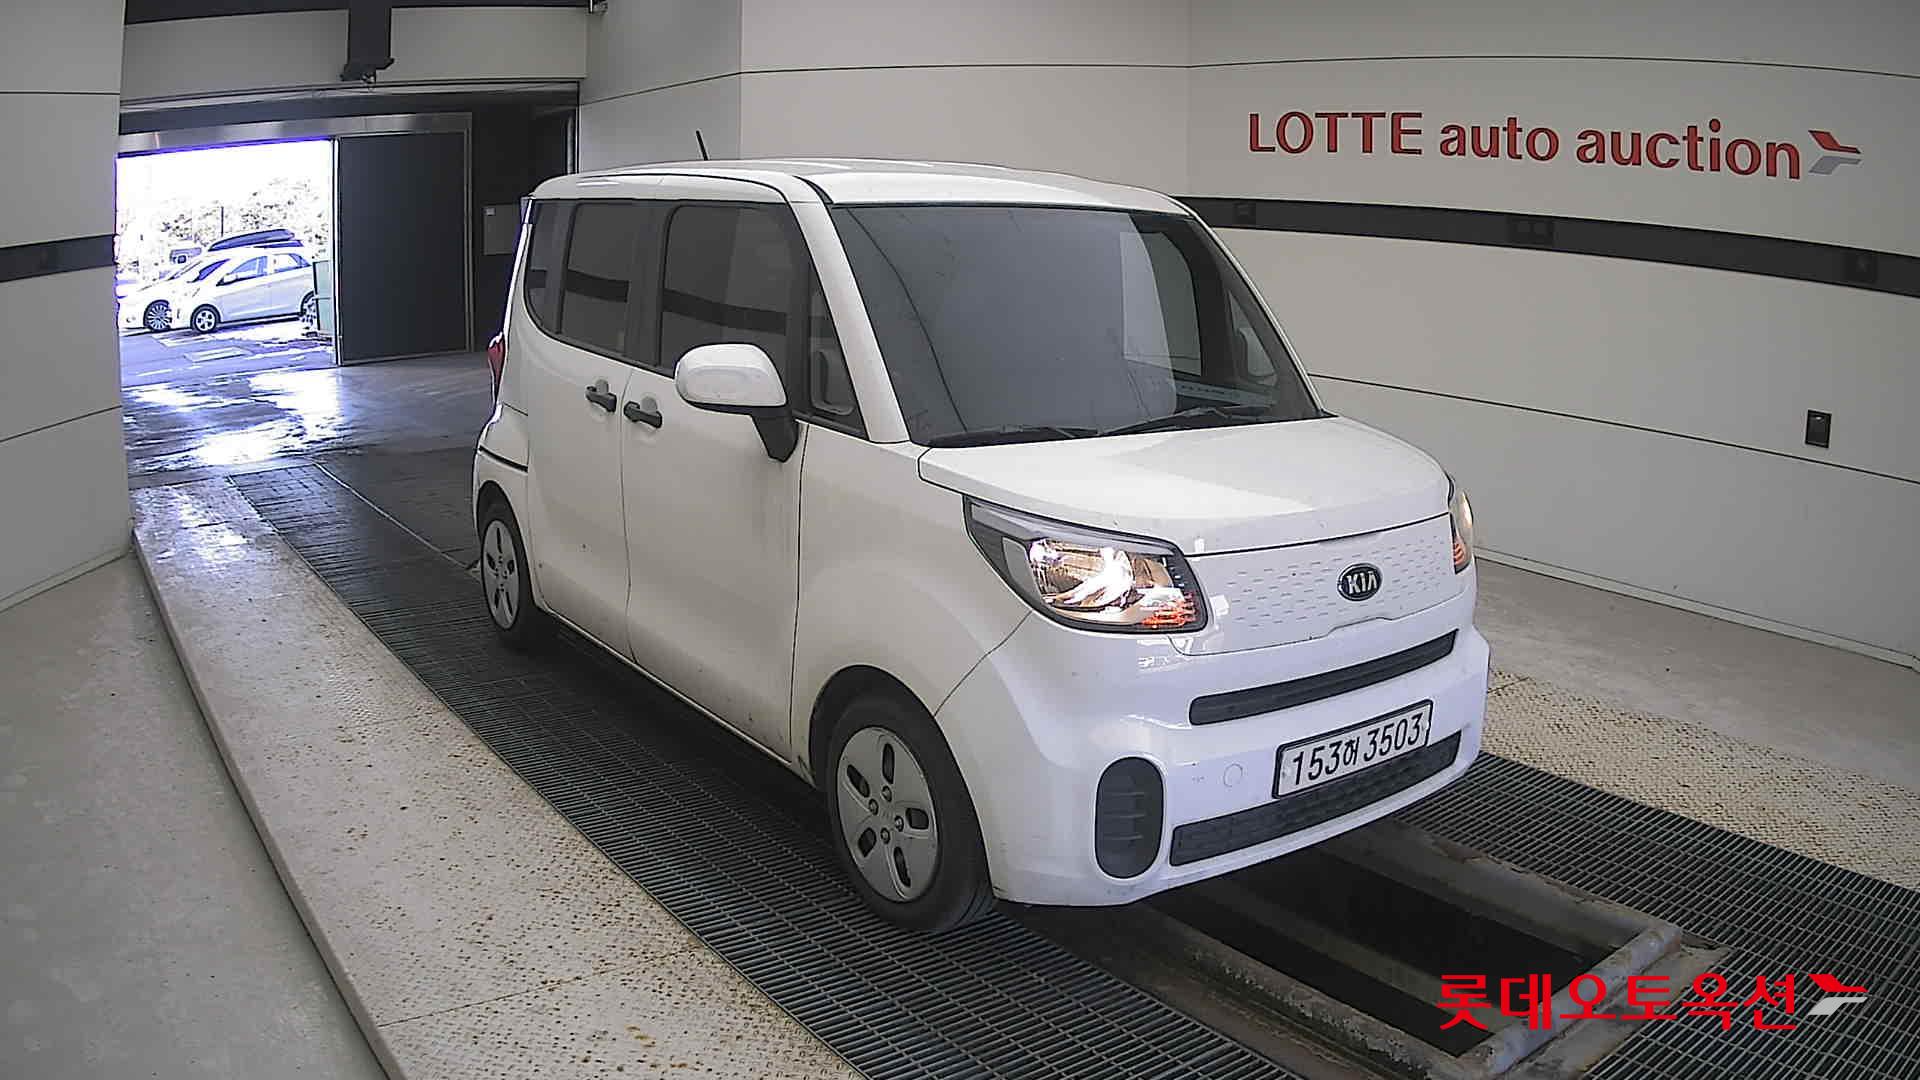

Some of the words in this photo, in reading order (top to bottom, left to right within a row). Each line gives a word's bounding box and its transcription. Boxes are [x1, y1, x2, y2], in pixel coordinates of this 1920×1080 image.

[1249, 112, 1424, 155] LOTTE
[1440, 116, 1560, 161] auto
[1576, 119, 1801, 180] auction
[1346, 571, 1377, 594] KIA
[1293, 737, 1361, 785] 153허
[1363, 713, 1423, 762] 3503
